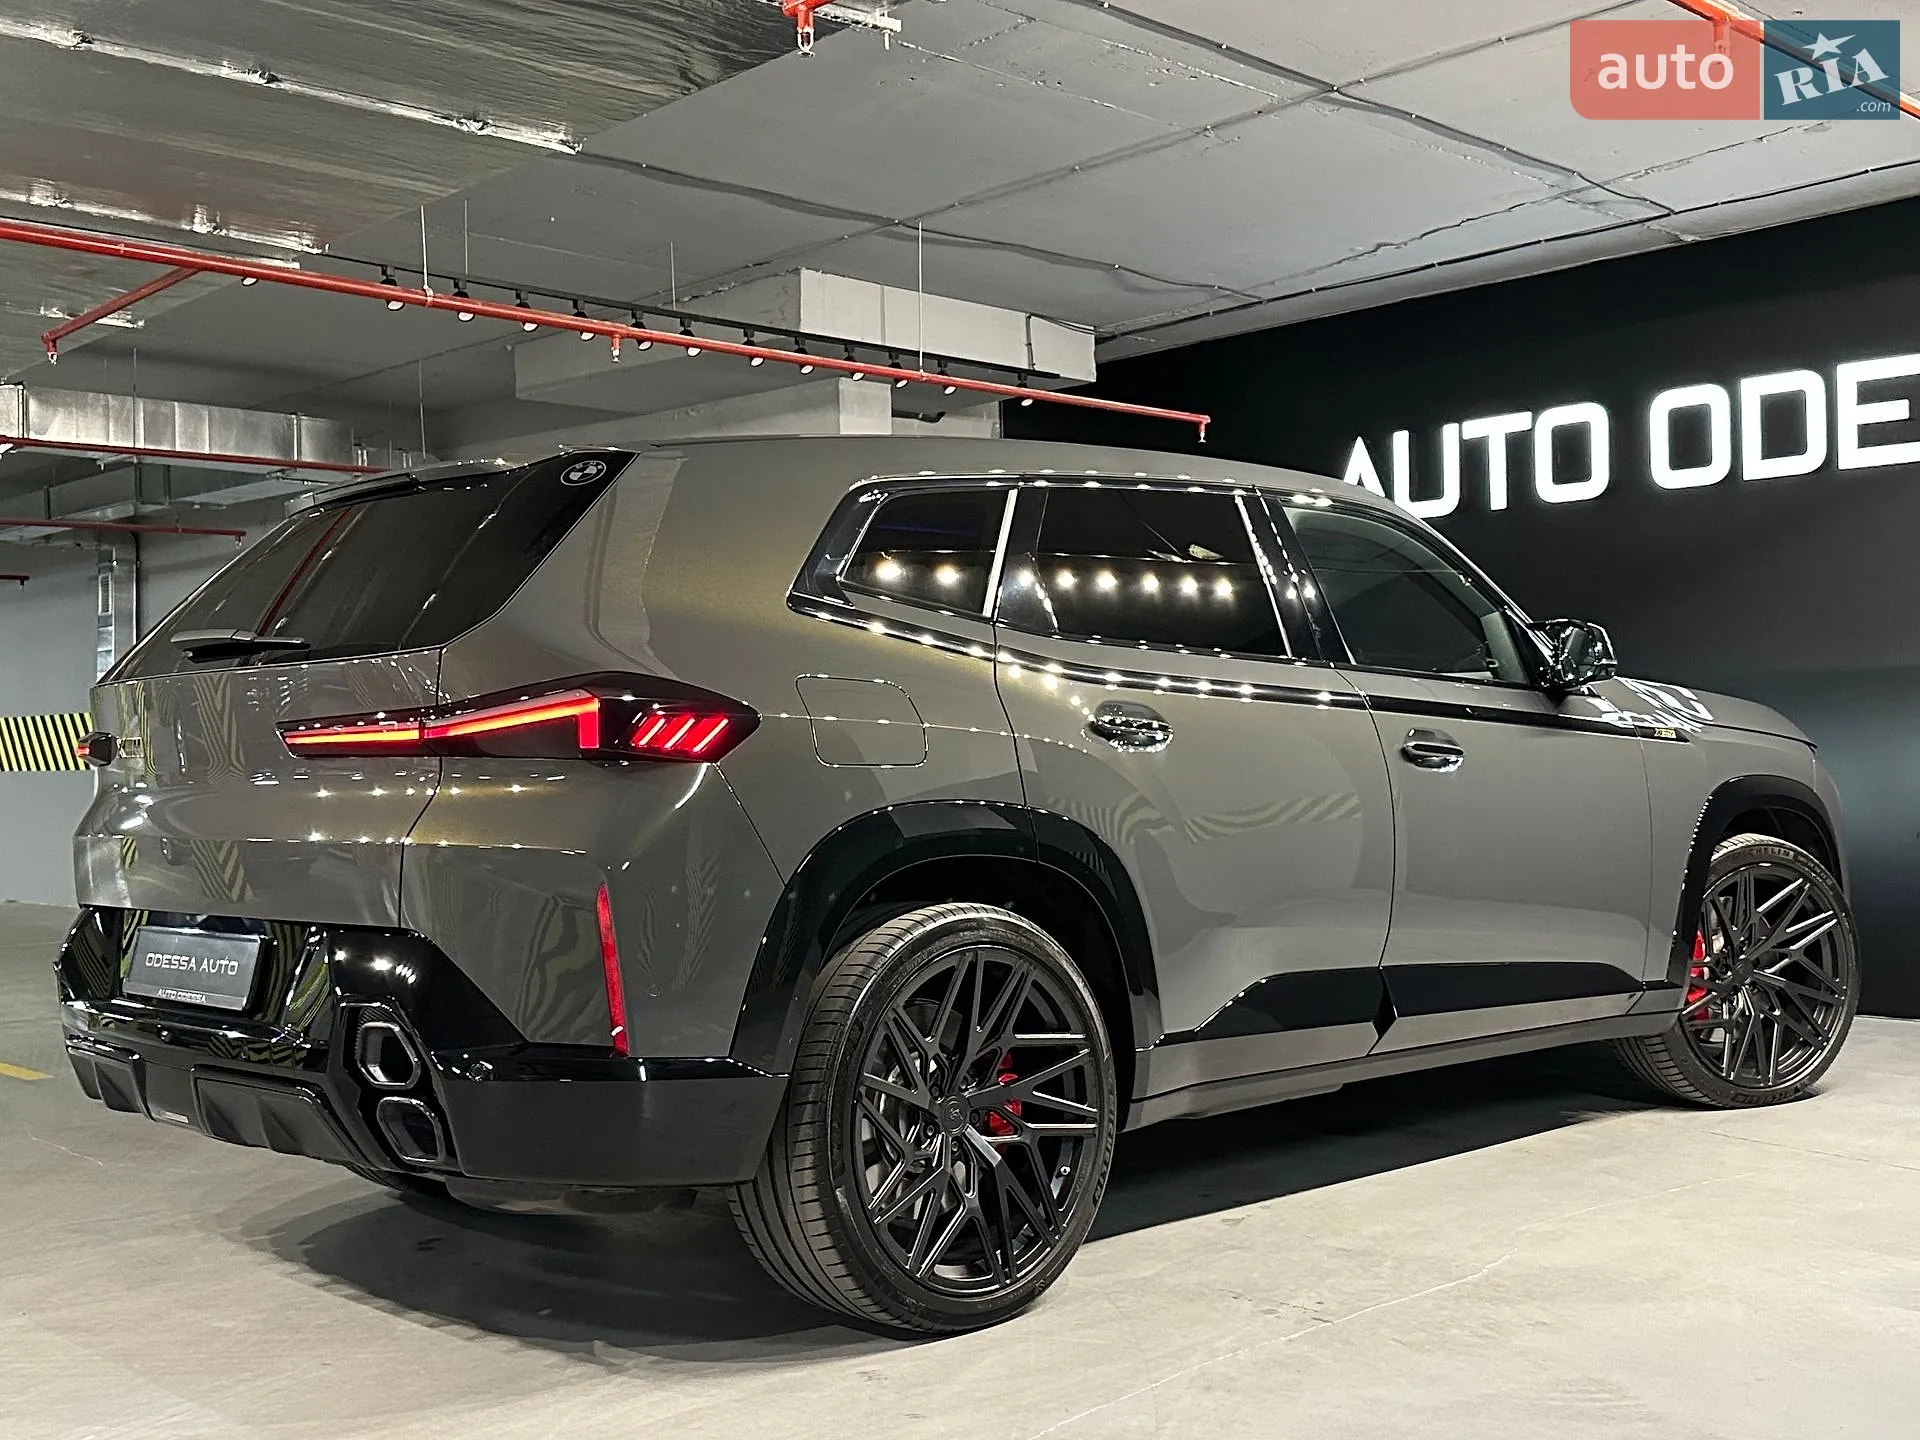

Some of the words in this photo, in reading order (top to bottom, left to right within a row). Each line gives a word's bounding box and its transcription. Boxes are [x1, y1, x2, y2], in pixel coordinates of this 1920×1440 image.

[1342, 401, 1610, 519] AUTO
[146, 953, 196, 971] ODESSA
[200, 957, 238, 975] AUTO
